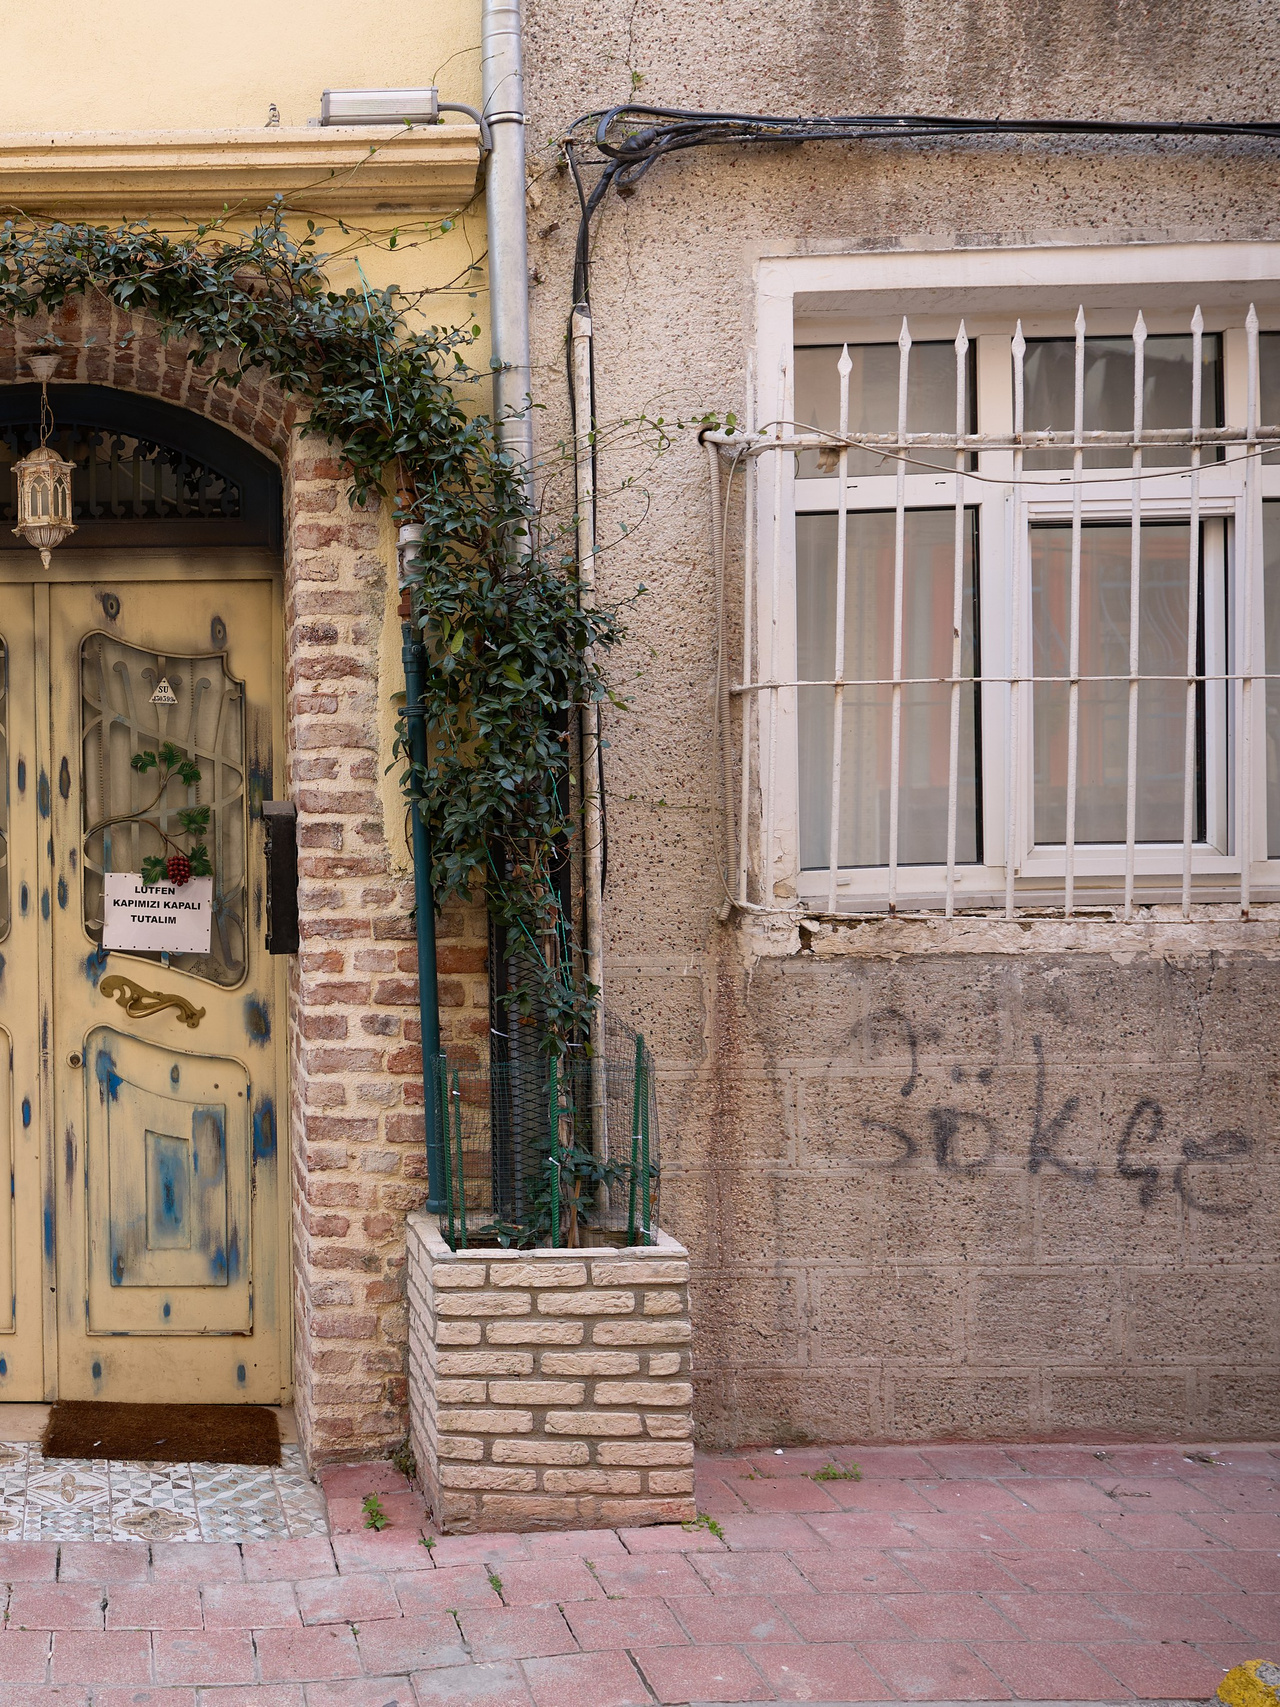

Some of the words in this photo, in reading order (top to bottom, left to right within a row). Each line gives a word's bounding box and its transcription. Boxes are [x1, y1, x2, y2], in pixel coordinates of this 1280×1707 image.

[112, 899, 160, 908] KAPIMIZI
[163, 902, 201, 910] KAPALI
[130, 914, 177, 924] TUTALIM
